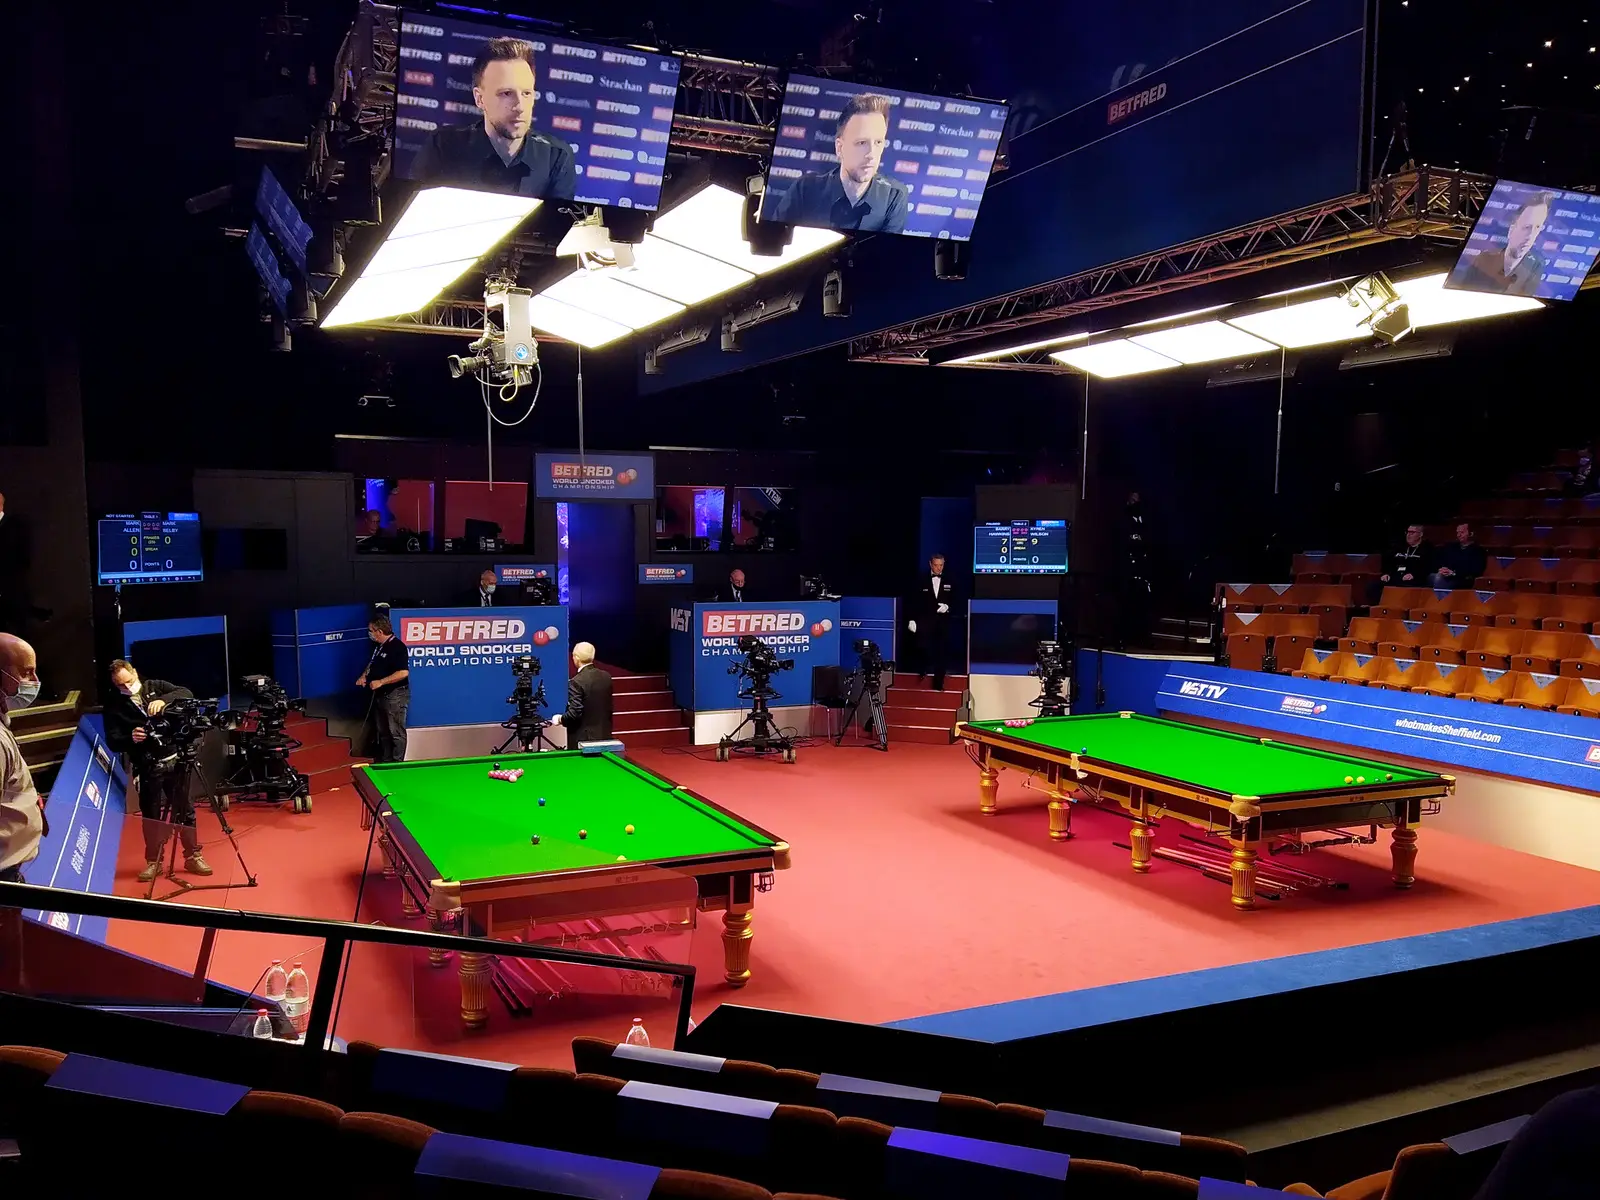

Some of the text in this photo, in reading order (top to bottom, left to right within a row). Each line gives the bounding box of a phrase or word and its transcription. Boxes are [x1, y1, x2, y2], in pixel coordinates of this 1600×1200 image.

[600, 76, 642, 92] Strachan
[1110, 83, 1167, 121] BETFRED
[939, 124, 974, 138] Strachan
[553, 465, 613, 477] BETFRED
[131, 536, 138, 545] 0
[164, 536, 171, 545] 0
[131, 548, 138, 557] 0
[129, 560, 137, 570] 0
[165, 559, 173, 569] 0
[999, 555, 1007, 564] 0
[1032, 555, 1039, 564] 0
[671, 608, 691, 632] WST
[707, 614, 805, 633] BETFRED
[406, 620, 526, 642] BETFRED
[702, 635, 809, 646] WORL NOOKER
[460, 644, 532, 655] SNOOKER
[408, 655, 514, 667] HAMPIONSH
[1283, 697, 1315, 709] BETFRED
[1395, 718, 1502, 743] whatmakesSheffield.com
